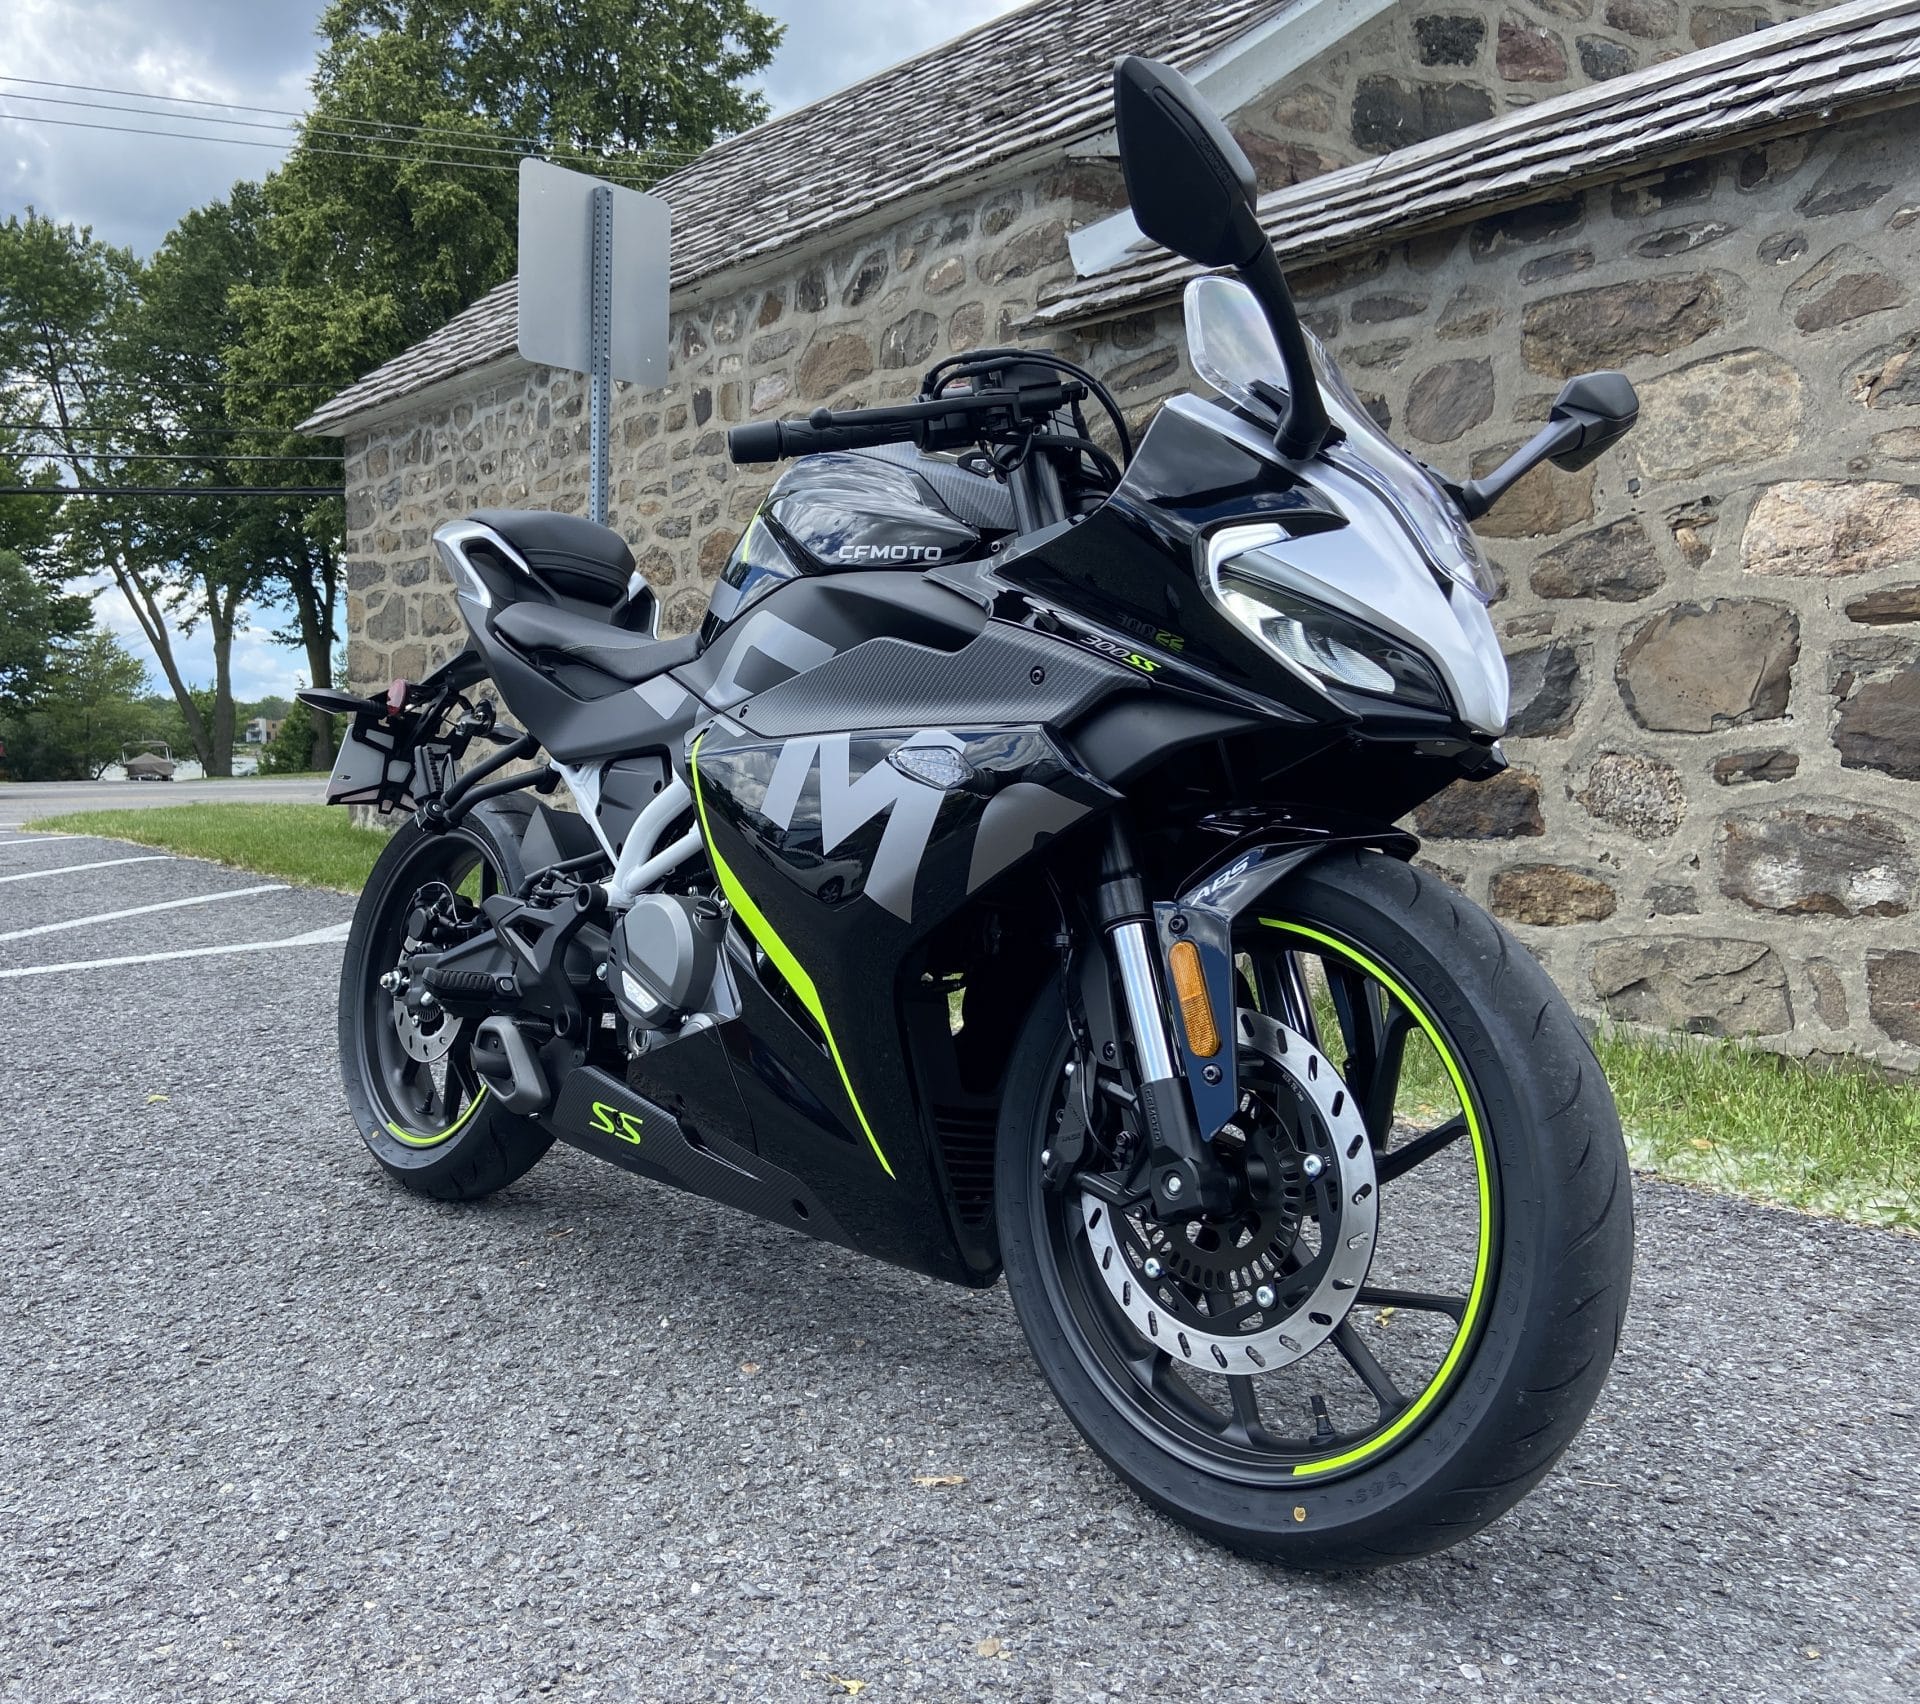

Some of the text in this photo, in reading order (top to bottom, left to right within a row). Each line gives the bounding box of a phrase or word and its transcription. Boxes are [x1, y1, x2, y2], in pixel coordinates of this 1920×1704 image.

[838, 545, 942, 562] CFMOTO
[1080, 634, 1161, 672] 300SS
[1191, 856, 1249, 906] ABS
[589, 1101, 643, 1145] SS
